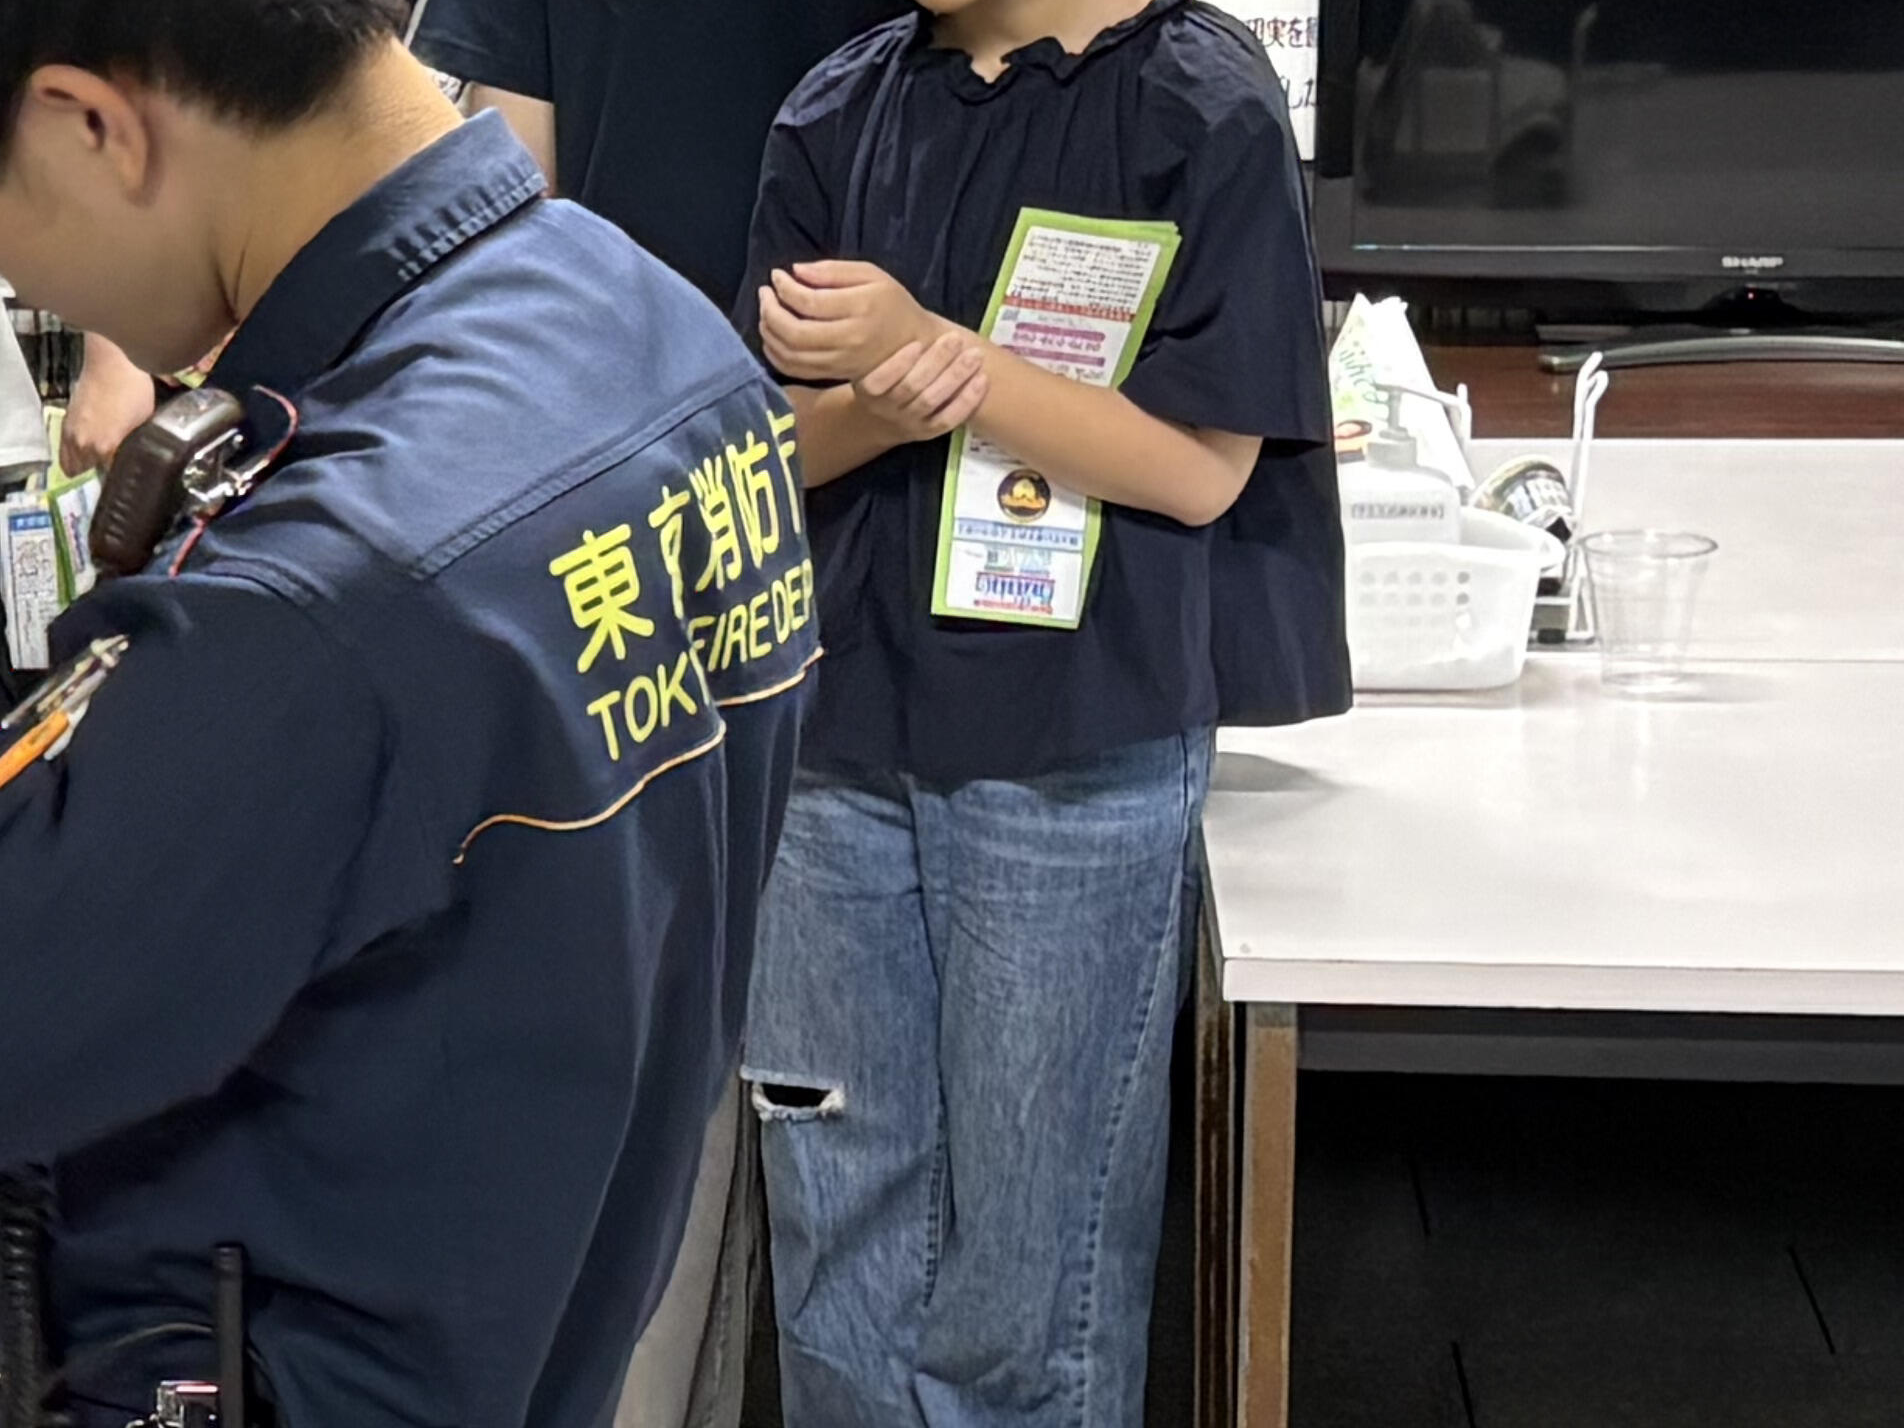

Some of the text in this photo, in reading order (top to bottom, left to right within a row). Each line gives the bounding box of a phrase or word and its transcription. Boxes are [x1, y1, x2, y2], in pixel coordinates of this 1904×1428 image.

[586, 558, 815, 762] TOK FIRE DEP
